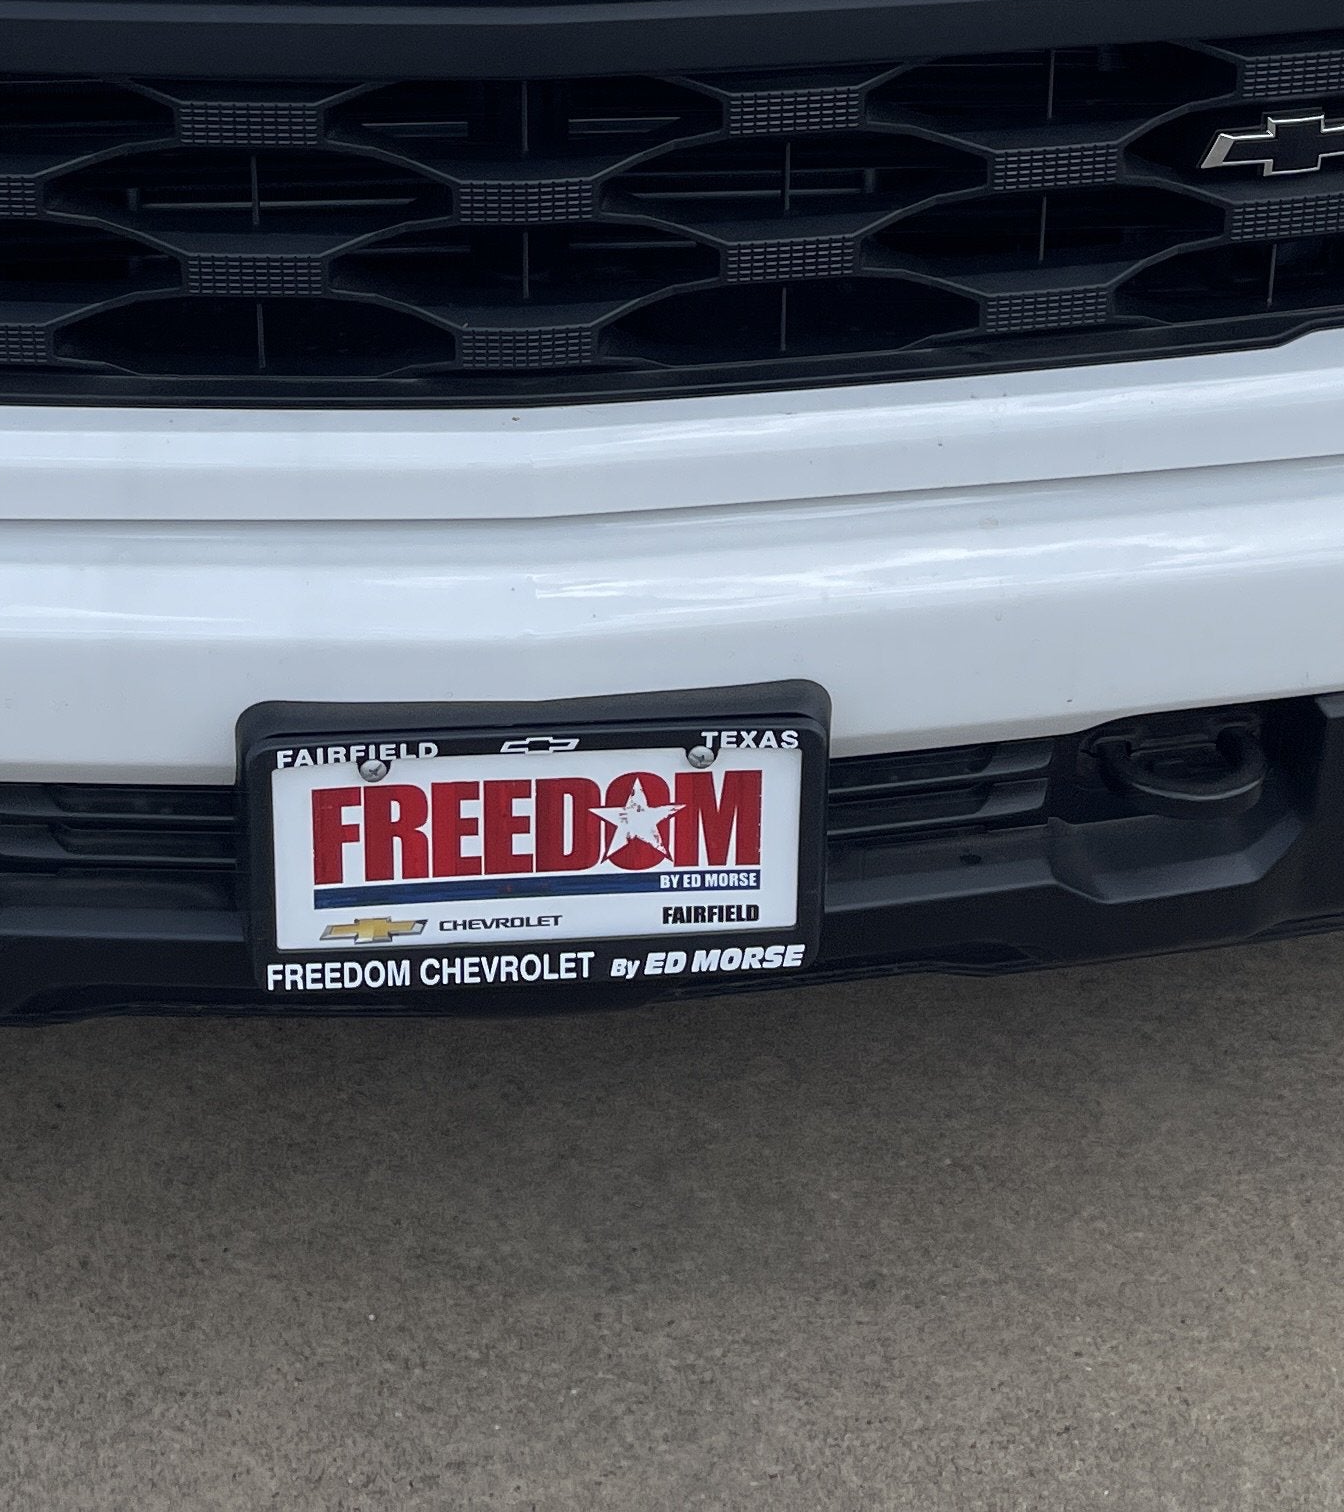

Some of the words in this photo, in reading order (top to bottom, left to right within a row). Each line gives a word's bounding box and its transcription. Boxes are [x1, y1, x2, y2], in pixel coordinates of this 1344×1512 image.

[276, 741, 439, 769] FAIRFIELD
[700, 730, 799, 749] TEXAS
[311, 769, 763, 886] FREEDOM
[659, 873, 680, 889] BY
[683, 873, 702, 888] ED
[705, 872, 757, 887] MORSE
[439, 915, 563, 932] CHEVROLET
[662, 904, 760, 925] FAIRFIELD
[266, 958, 411, 991] FREEDOM
[419, 951, 595, 986] CHEVROLET
[610, 958, 640, 979] By
[644, 951, 687, 975] ED
[691, 944, 806, 973] MORSE
